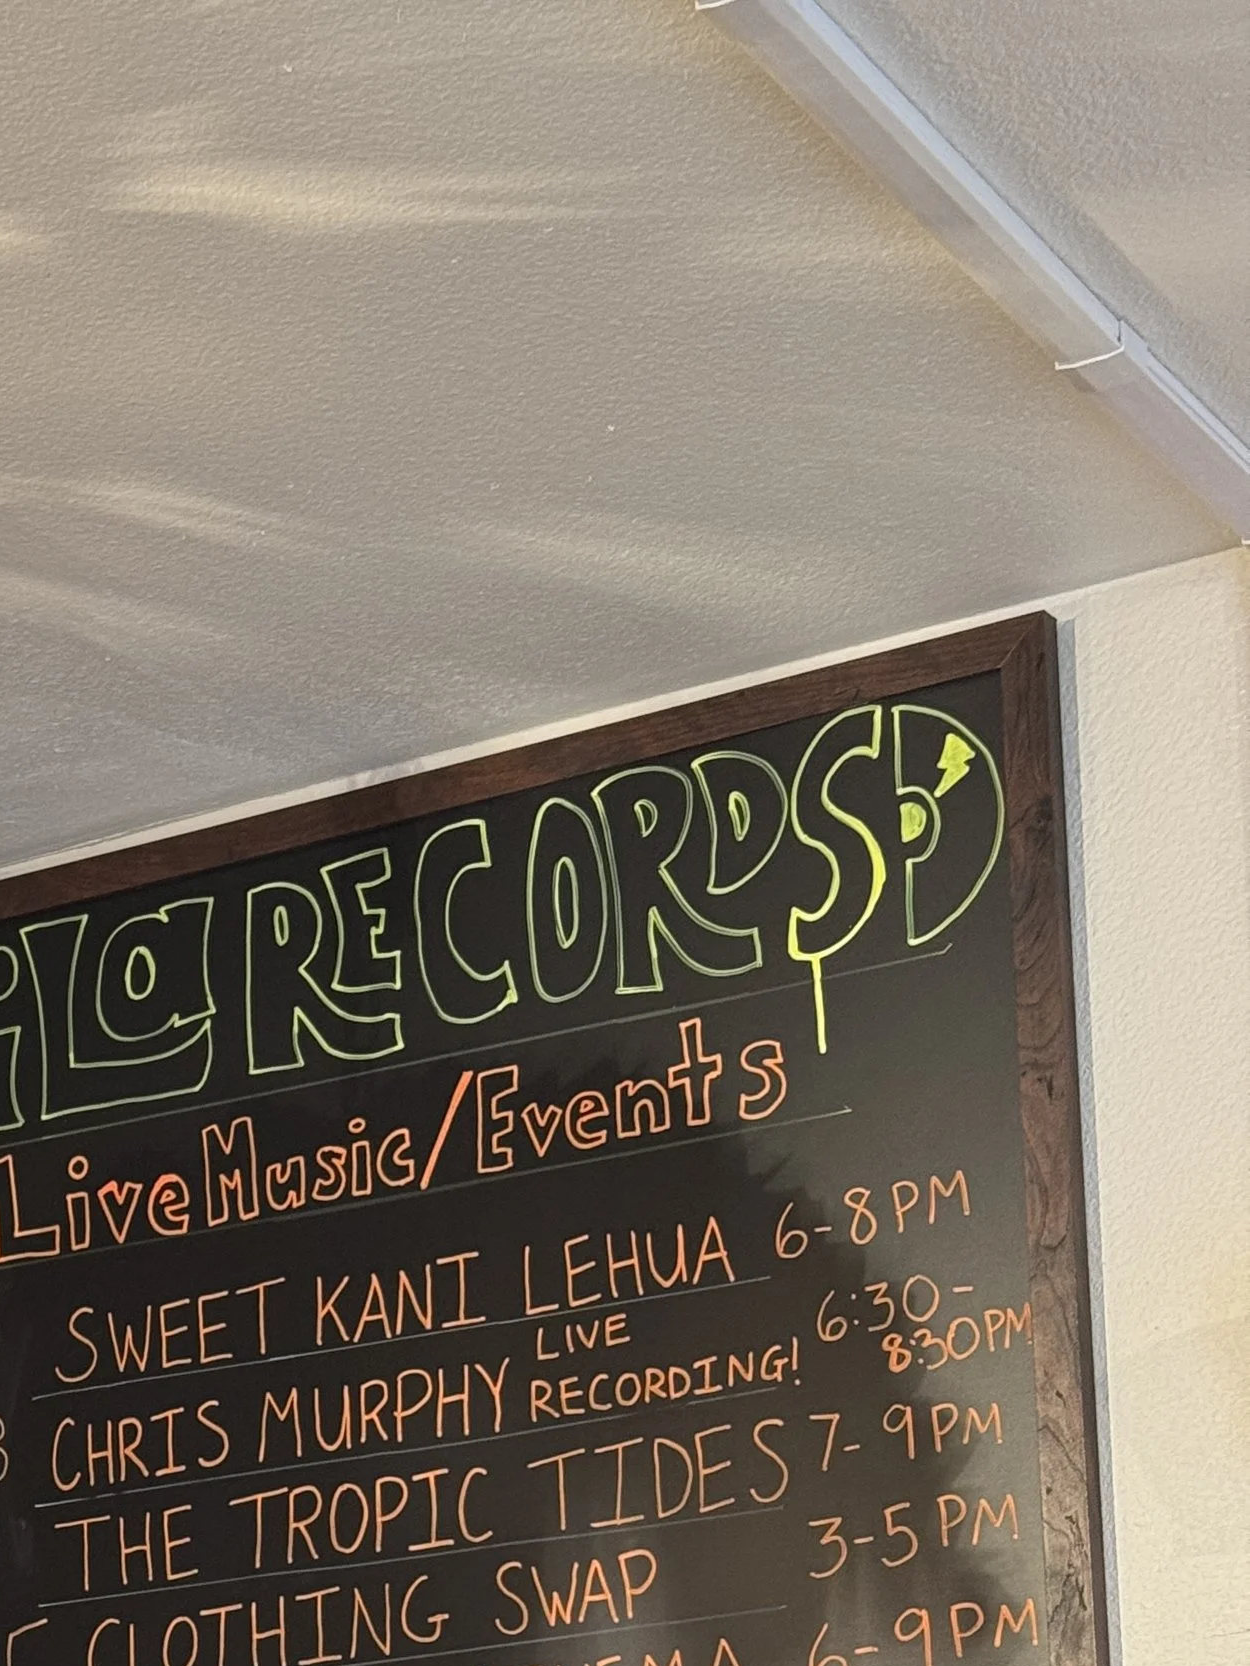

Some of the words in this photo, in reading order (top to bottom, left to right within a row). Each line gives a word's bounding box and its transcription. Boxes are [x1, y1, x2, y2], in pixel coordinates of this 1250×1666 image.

[246, 705, 886, 1074] RECORDS
[54, 1277, 285, 1383] SWEET
[316, 1251, 485, 1345] KANI
[524, 1216, 735, 1317] LEHUA
[536, 1313, 631, 1360] LIVE
[52, 1400, 230, 1491] CHRIS
[258, 1356, 510, 1463] MURPHY
[530, 1337, 802, 1422] RECORDING!
[55, 1505, 198, 1591] THE
[228, 1466, 494, 1569] TROPIC
[526, 1418, 789, 1531] TIDES
[495, 1549, 657, 1635] SWAP
